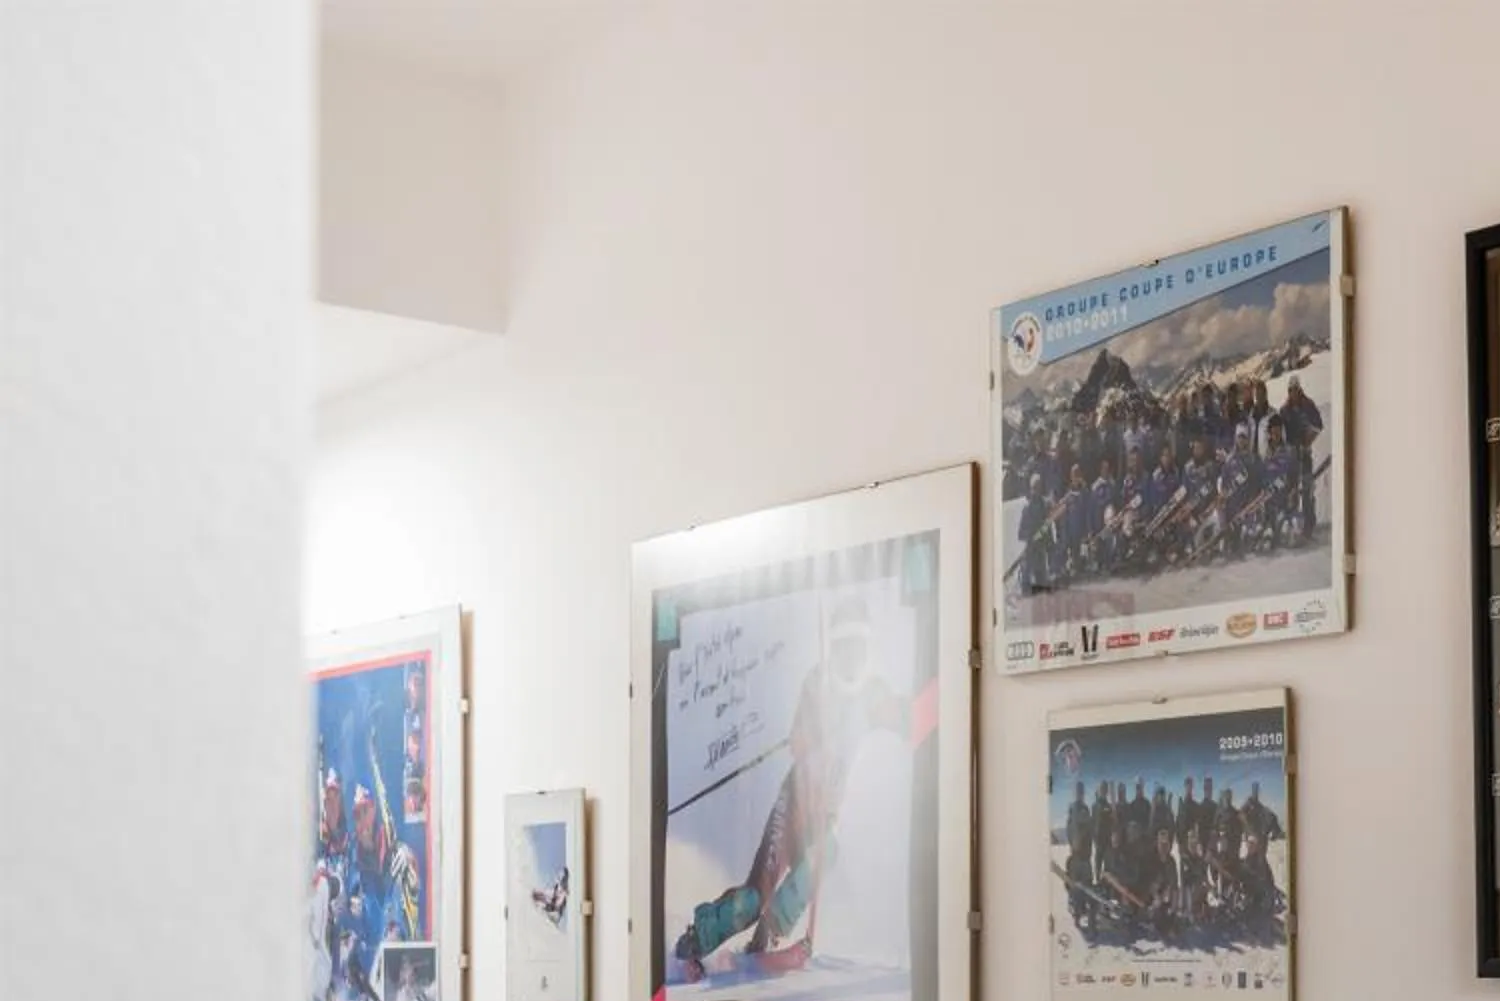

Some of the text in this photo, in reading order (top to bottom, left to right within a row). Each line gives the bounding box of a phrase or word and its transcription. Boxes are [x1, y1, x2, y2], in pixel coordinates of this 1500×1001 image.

[1045, 245, 1278, 323] GROUPE COUPE D'EUROPE
